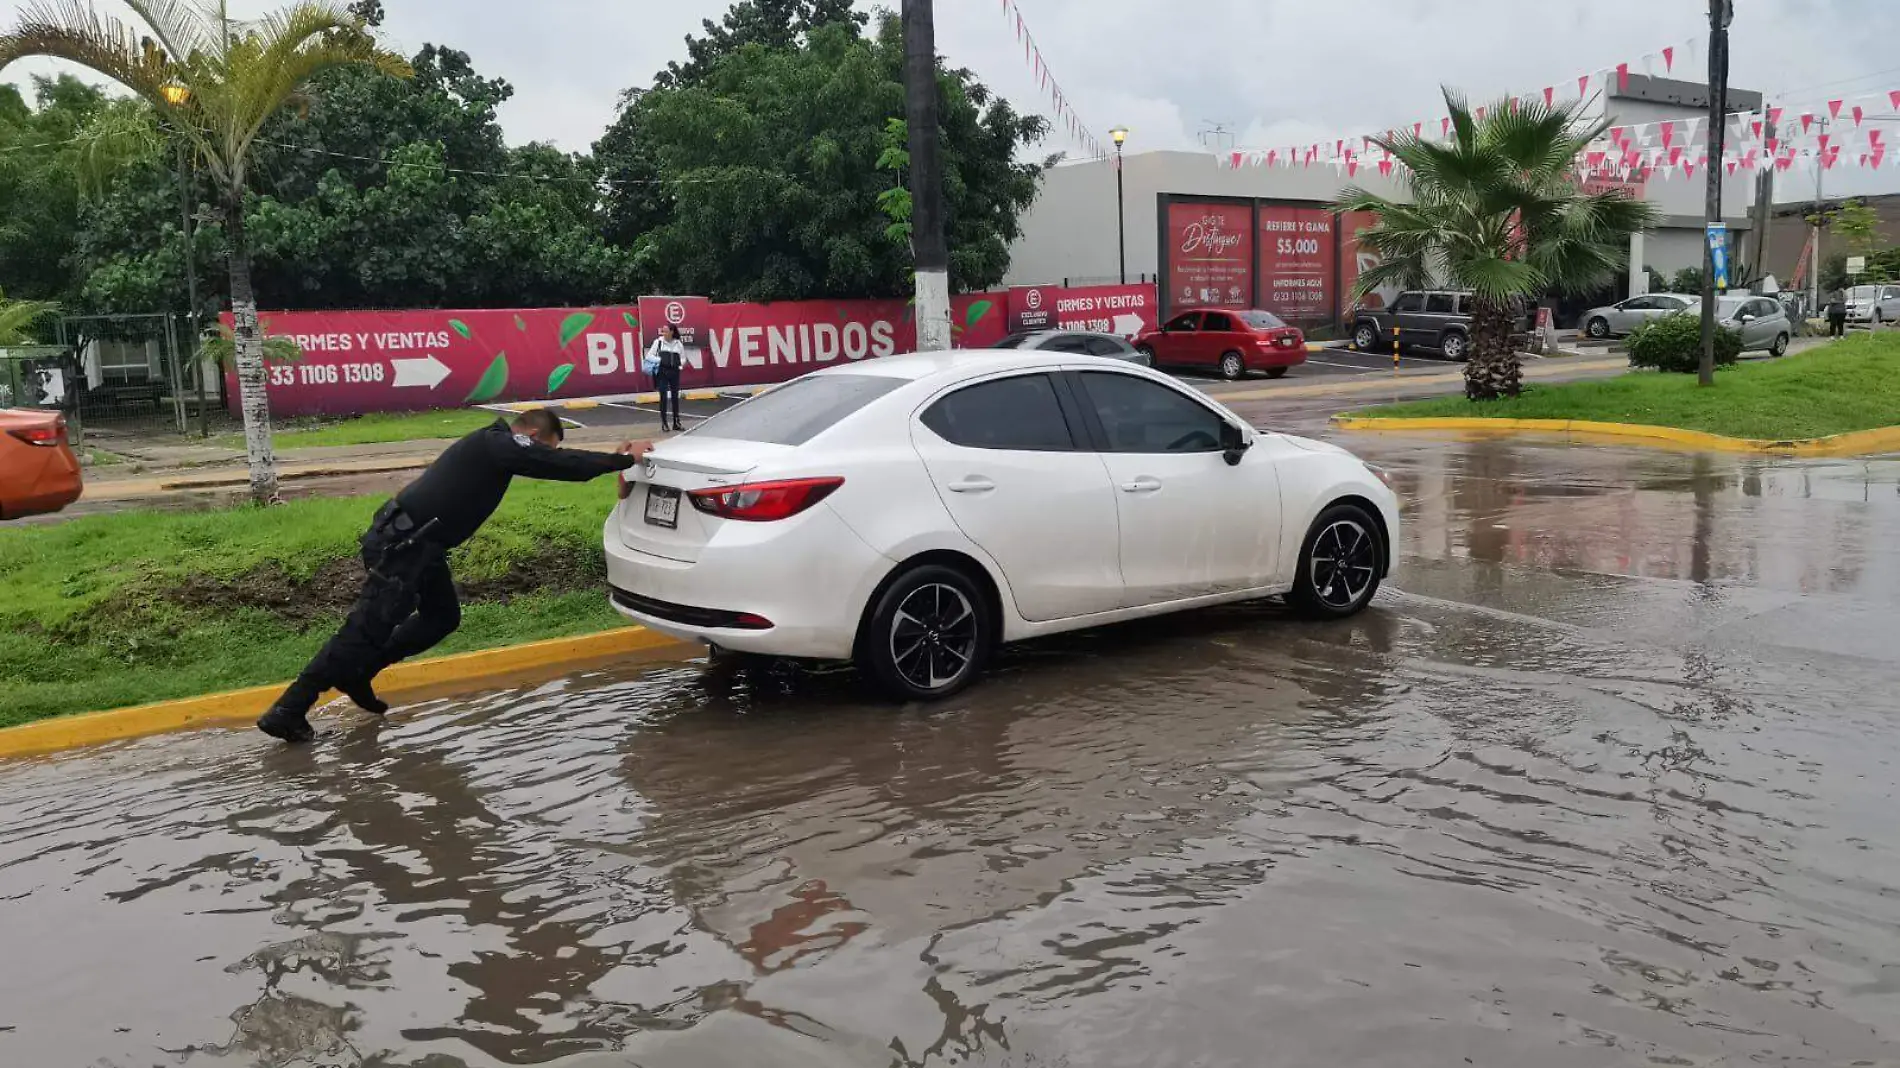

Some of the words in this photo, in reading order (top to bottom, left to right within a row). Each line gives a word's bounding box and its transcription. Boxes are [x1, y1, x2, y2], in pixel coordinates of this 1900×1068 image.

[1266, 220, 1296, 232] REFIERE
[1298, 221, 1304, 232] Y
[1306, 221, 1330, 233] GANA
[1276, 238, 1318, 255] $5,000
[1057, 297, 1093, 312] ORMES
[1094, 297, 1102, 310] Y
[1104, 294, 1144, 309] VENTAS
[356, 332, 367, 350] Y
[373, 331, 449, 350] VENTAS
[270, 364, 294, 386] 33
[298, 363, 338, 385] 1106
[341, 362, 384, 383] 1308
